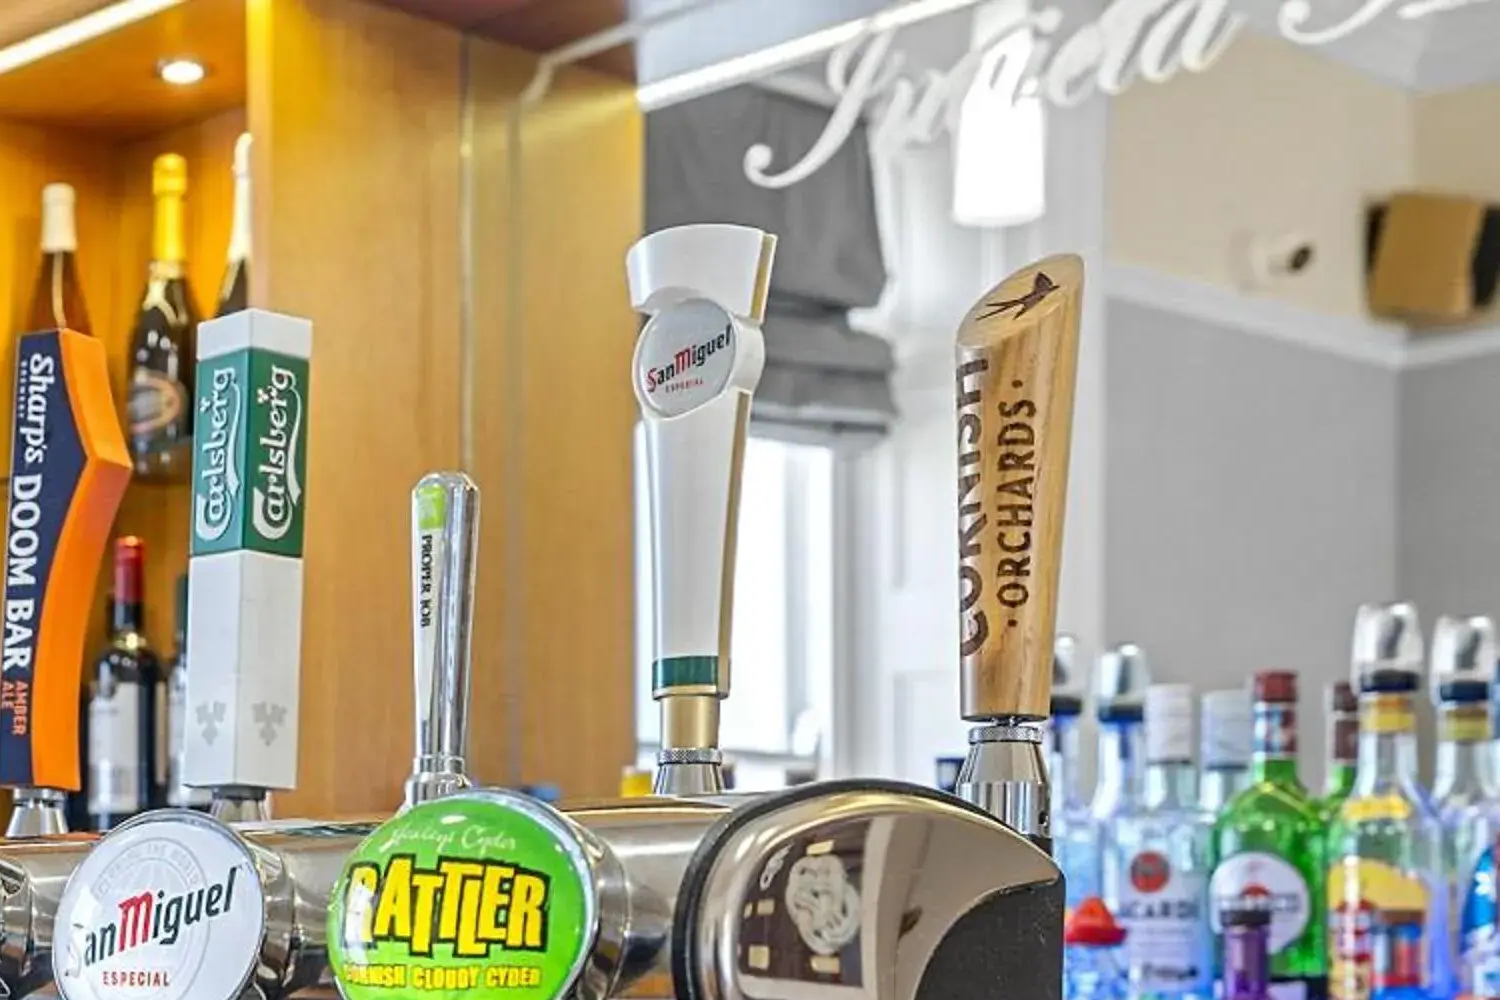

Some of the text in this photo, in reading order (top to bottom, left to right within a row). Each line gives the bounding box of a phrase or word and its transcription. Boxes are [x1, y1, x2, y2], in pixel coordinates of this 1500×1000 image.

[195, 367, 240, 540] Carlsberg
[252, 365, 302, 540] Carlsberg
[996, 400, 1037, 610] ORCHARDS
[3, 353, 55, 671] Sharp's DOOM BAR
[1, 680, 14, 709] ALE
[12, 679, 28, 736] AMBER
[342, 854, 551, 959] RATTLER
[103, 971, 170, 986] ESPECIAL
[412, 965, 481, 990] CLOUDY
[485, 965, 541, 989] CYDER
